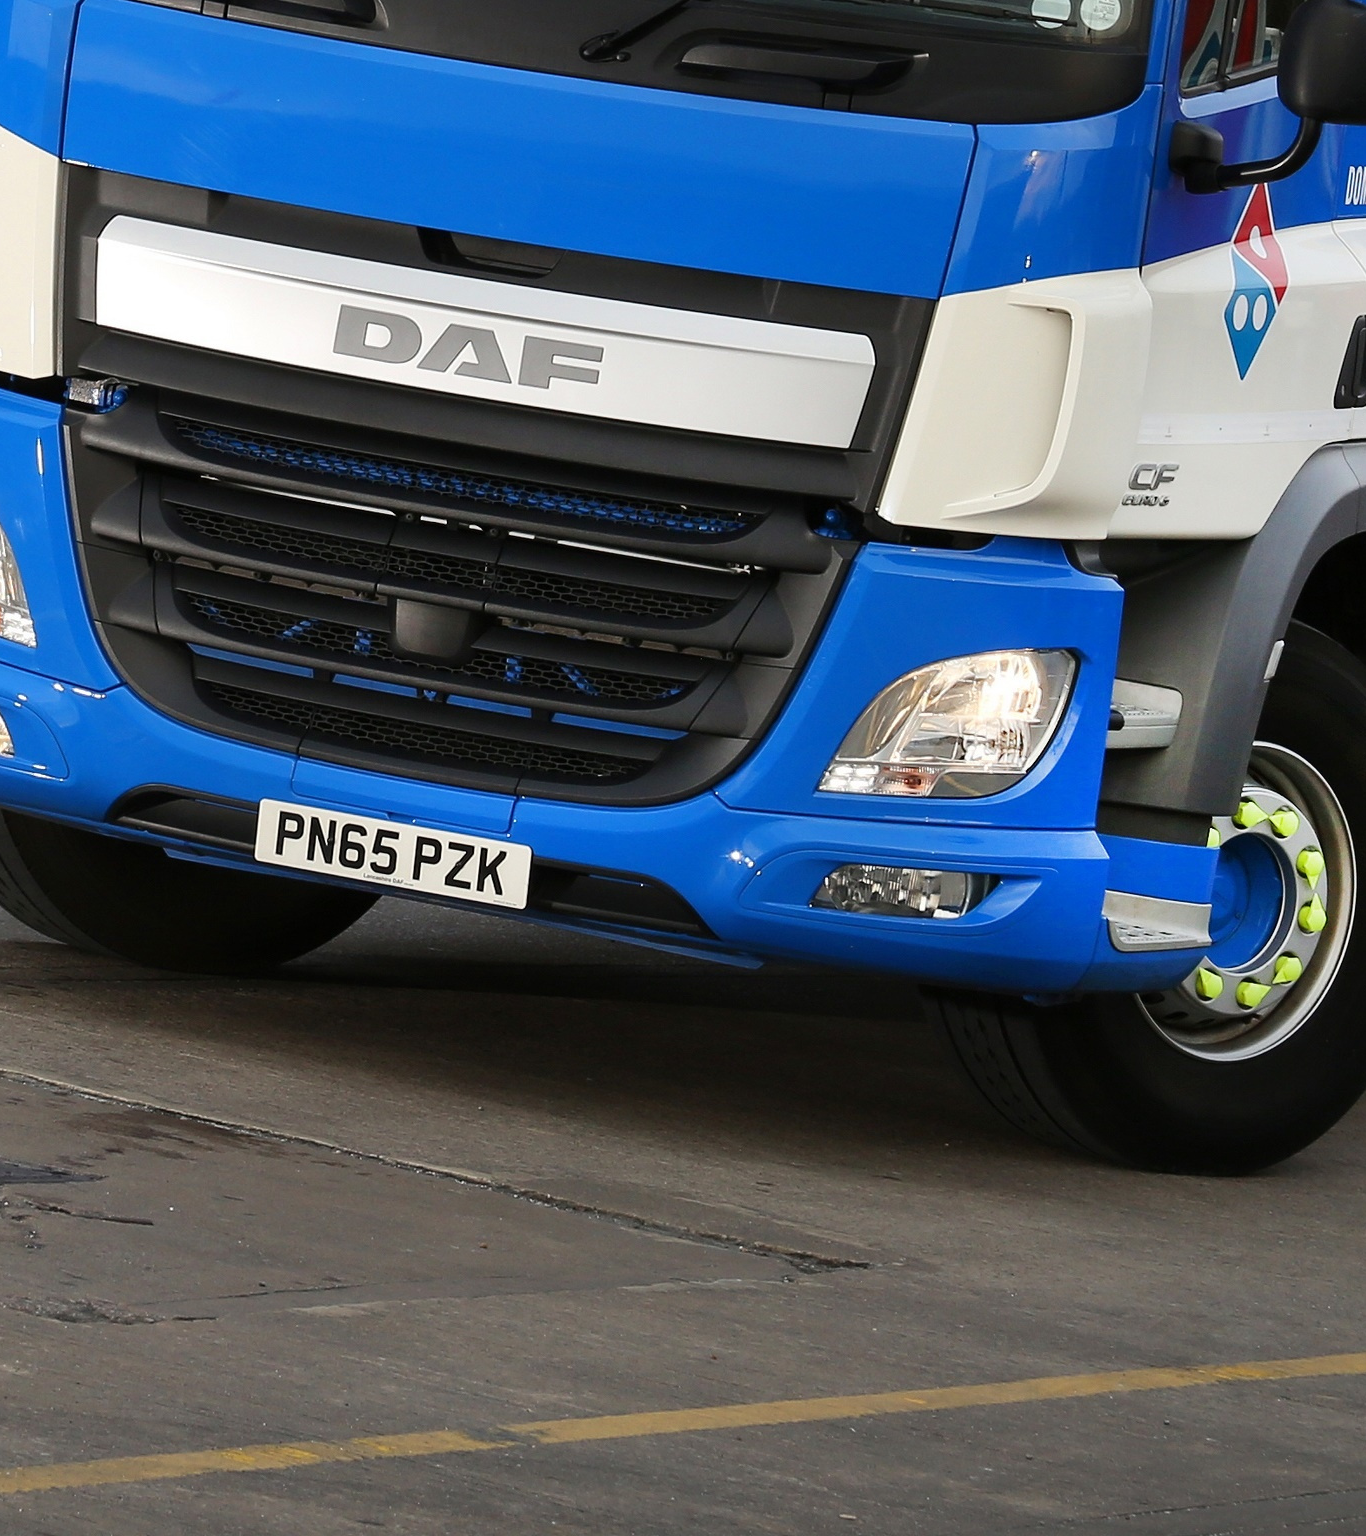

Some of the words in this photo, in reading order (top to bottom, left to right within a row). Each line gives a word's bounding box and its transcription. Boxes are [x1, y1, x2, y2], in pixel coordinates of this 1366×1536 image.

[333, 303, 604, 390] DAF
[1128, 462, 1180, 491] CF
[275, 810, 401, 875] PN65
[412, 835, 508, 896] PZK
[363, 872, 392, 883] Lancashire
